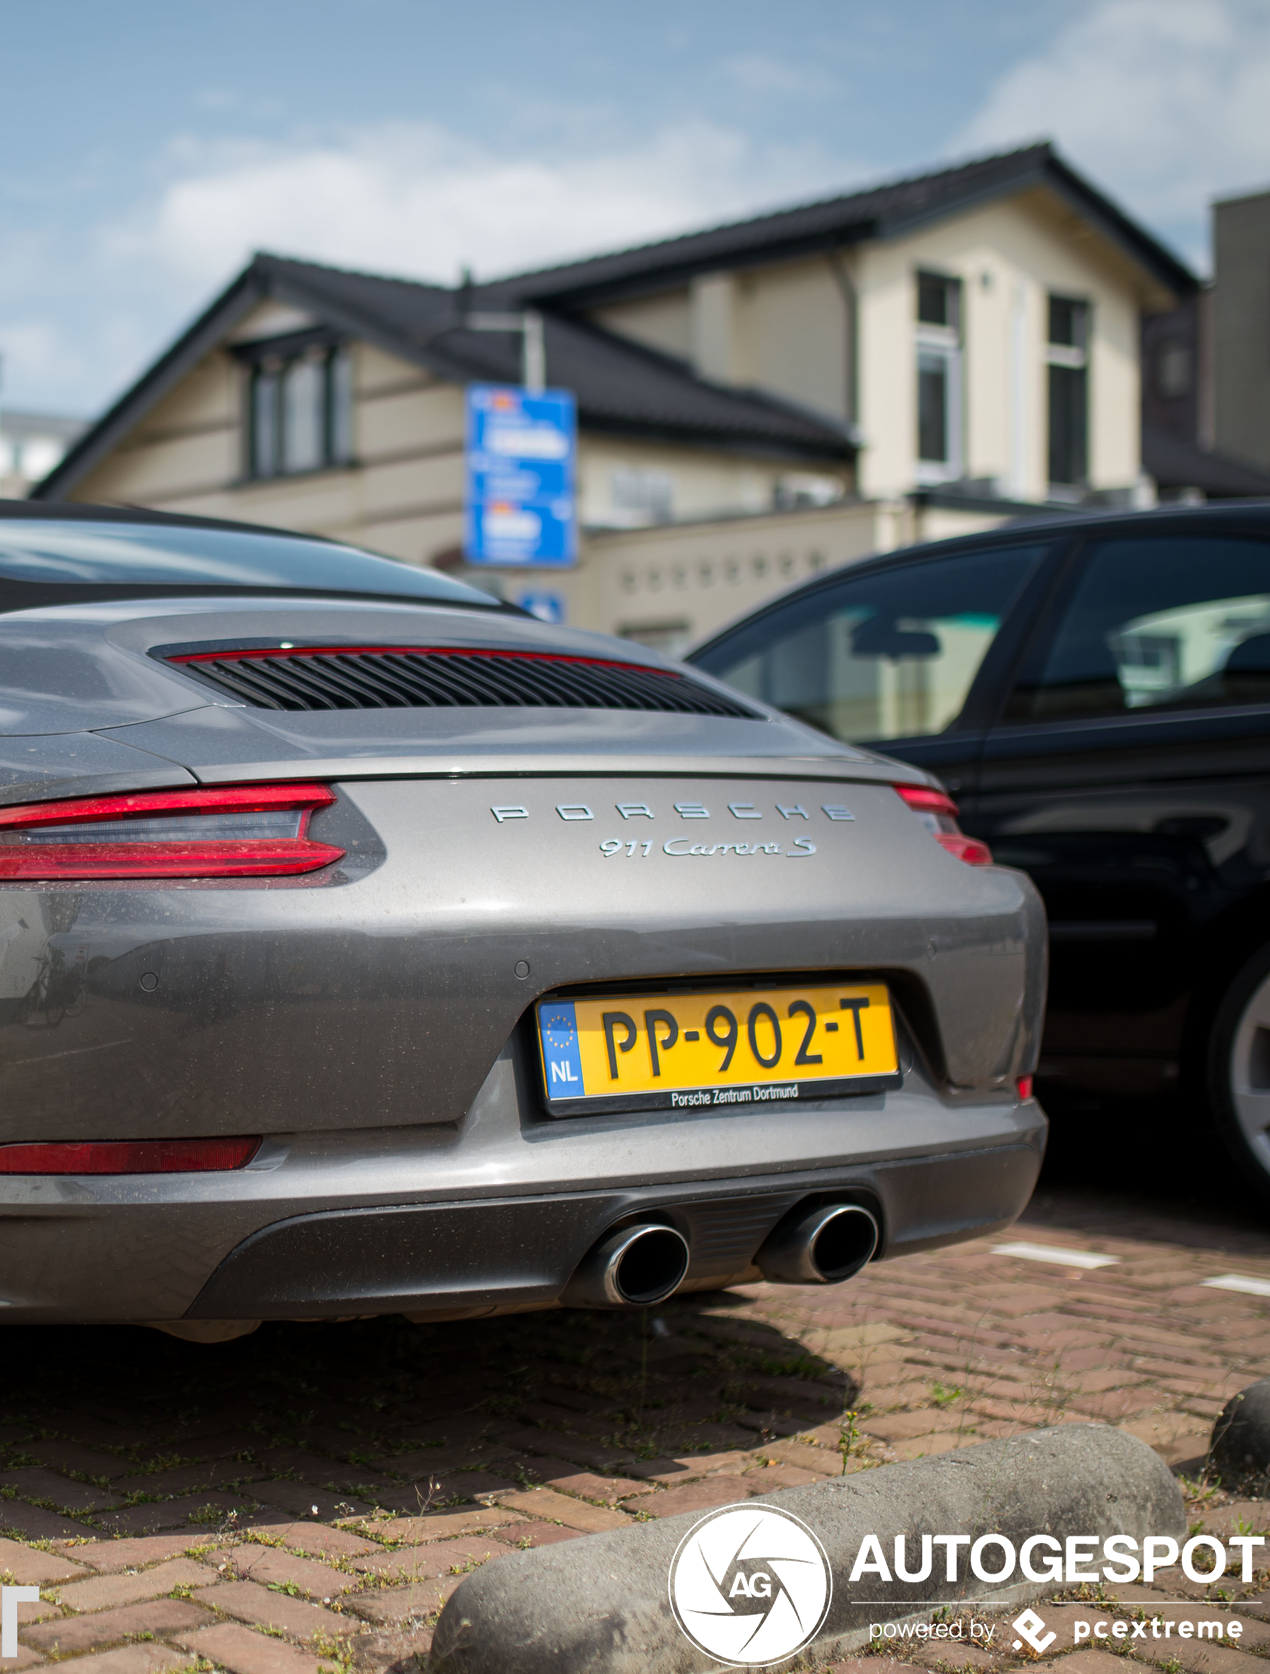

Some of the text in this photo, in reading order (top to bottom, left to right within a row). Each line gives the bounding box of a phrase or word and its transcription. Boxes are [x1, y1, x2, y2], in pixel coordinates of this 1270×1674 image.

[490, 802, 855, 823] PORSCHE
[599, 835, 818, 858] 911 Carrera S
[601, 997, 871, 1080] PP-902-T
[550, 1061, 579, 1083] NL
[671, 1084, 798, 1107] Porsche Zentrum Dortmund
